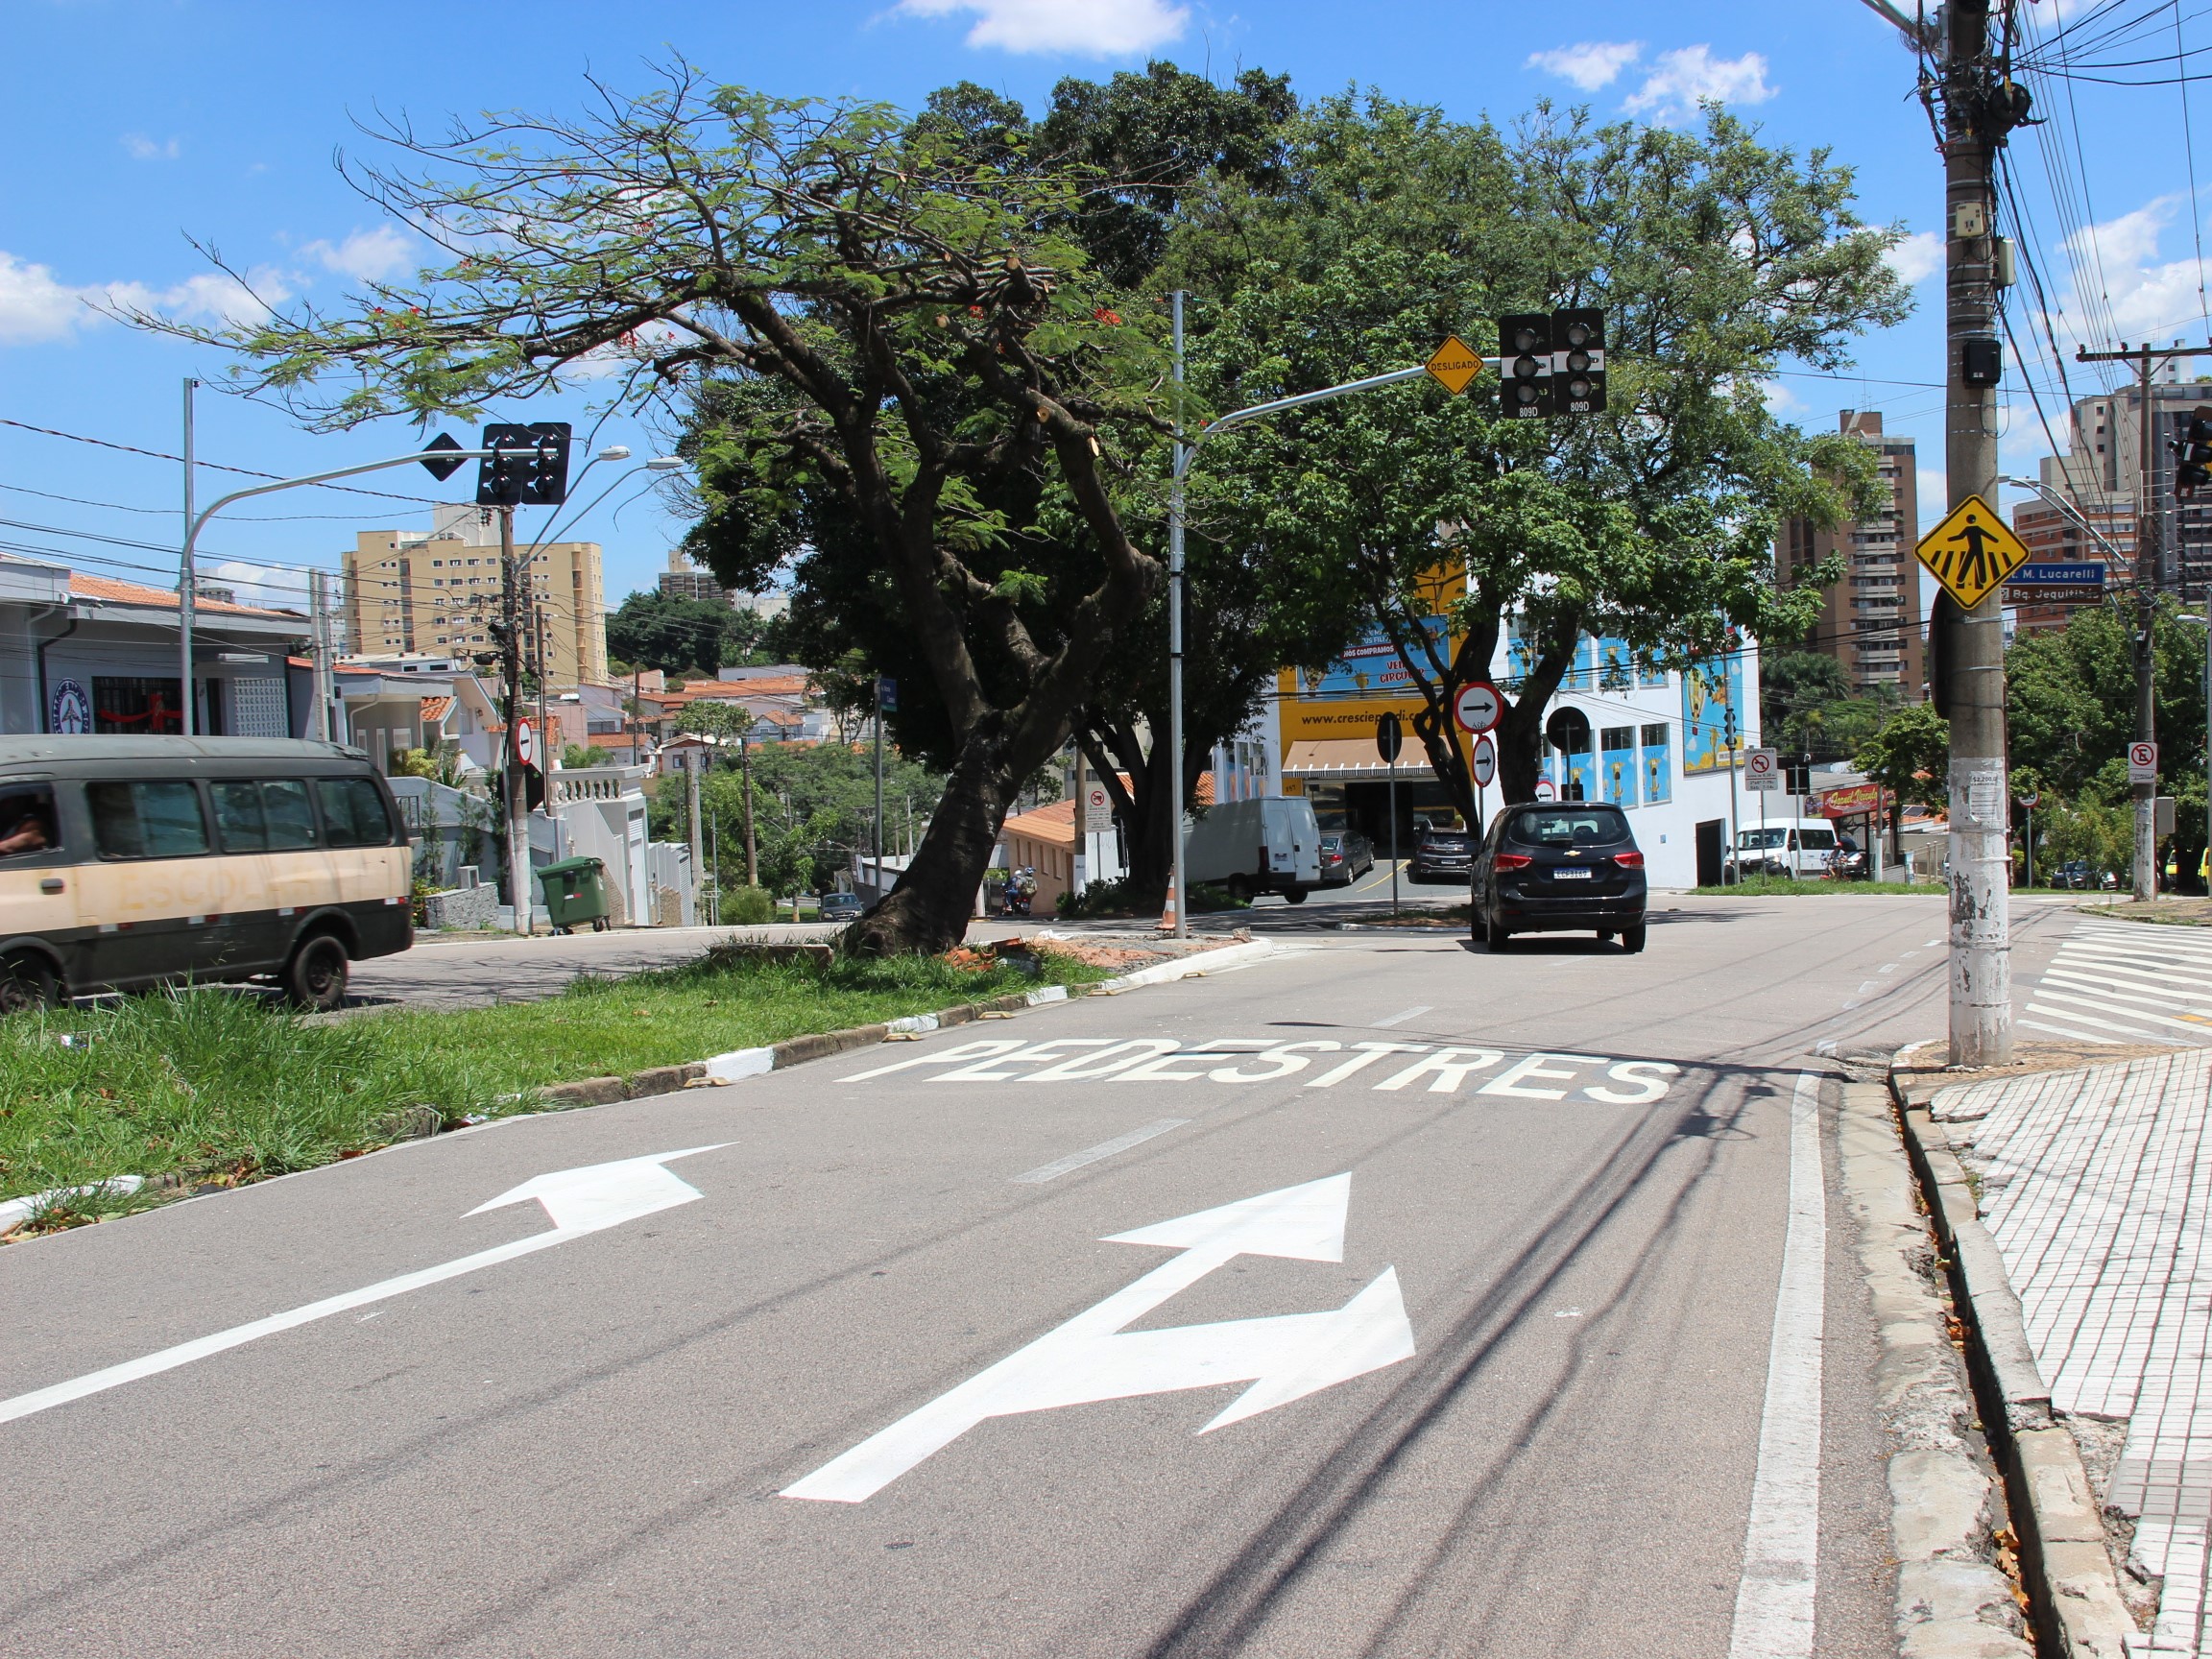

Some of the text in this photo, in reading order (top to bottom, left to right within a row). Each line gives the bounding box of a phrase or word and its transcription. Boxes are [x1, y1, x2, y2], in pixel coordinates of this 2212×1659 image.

[1431, 360, 1479, 372] DESLIGADO
[1519, 406, 1538, 418] 809D
[1570, 401, 1590, 413] 809D
[2023, 569, 2035, 579] M.
[2039, 568, 2095, 579] Lucarelli
[1356, 644, 1395, 657] COMPRAMOS
[832, 1036, 1682, 1106] PEDESTRES
